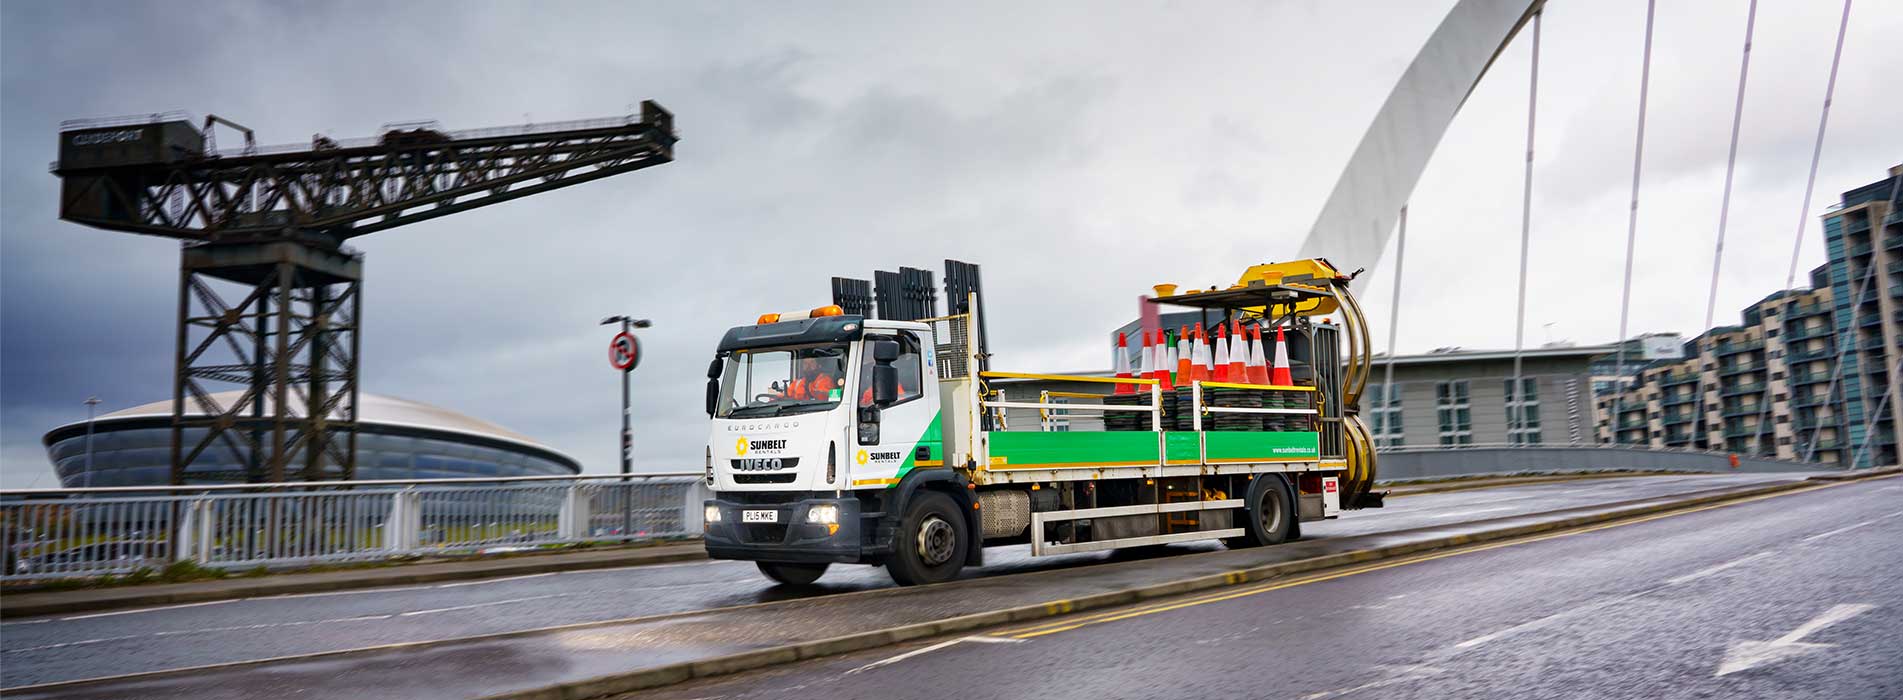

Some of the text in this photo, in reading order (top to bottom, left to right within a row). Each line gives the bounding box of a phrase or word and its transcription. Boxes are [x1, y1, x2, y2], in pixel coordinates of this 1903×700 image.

[727, 421, 800, 432] EUROCARGO
[750, 439, 787, 451] SUNBELT
[870, 451, 901, 461] SUNBELT
[740, 458, 783, 472] IVECO
[760, 511, 774, 521] MKE
